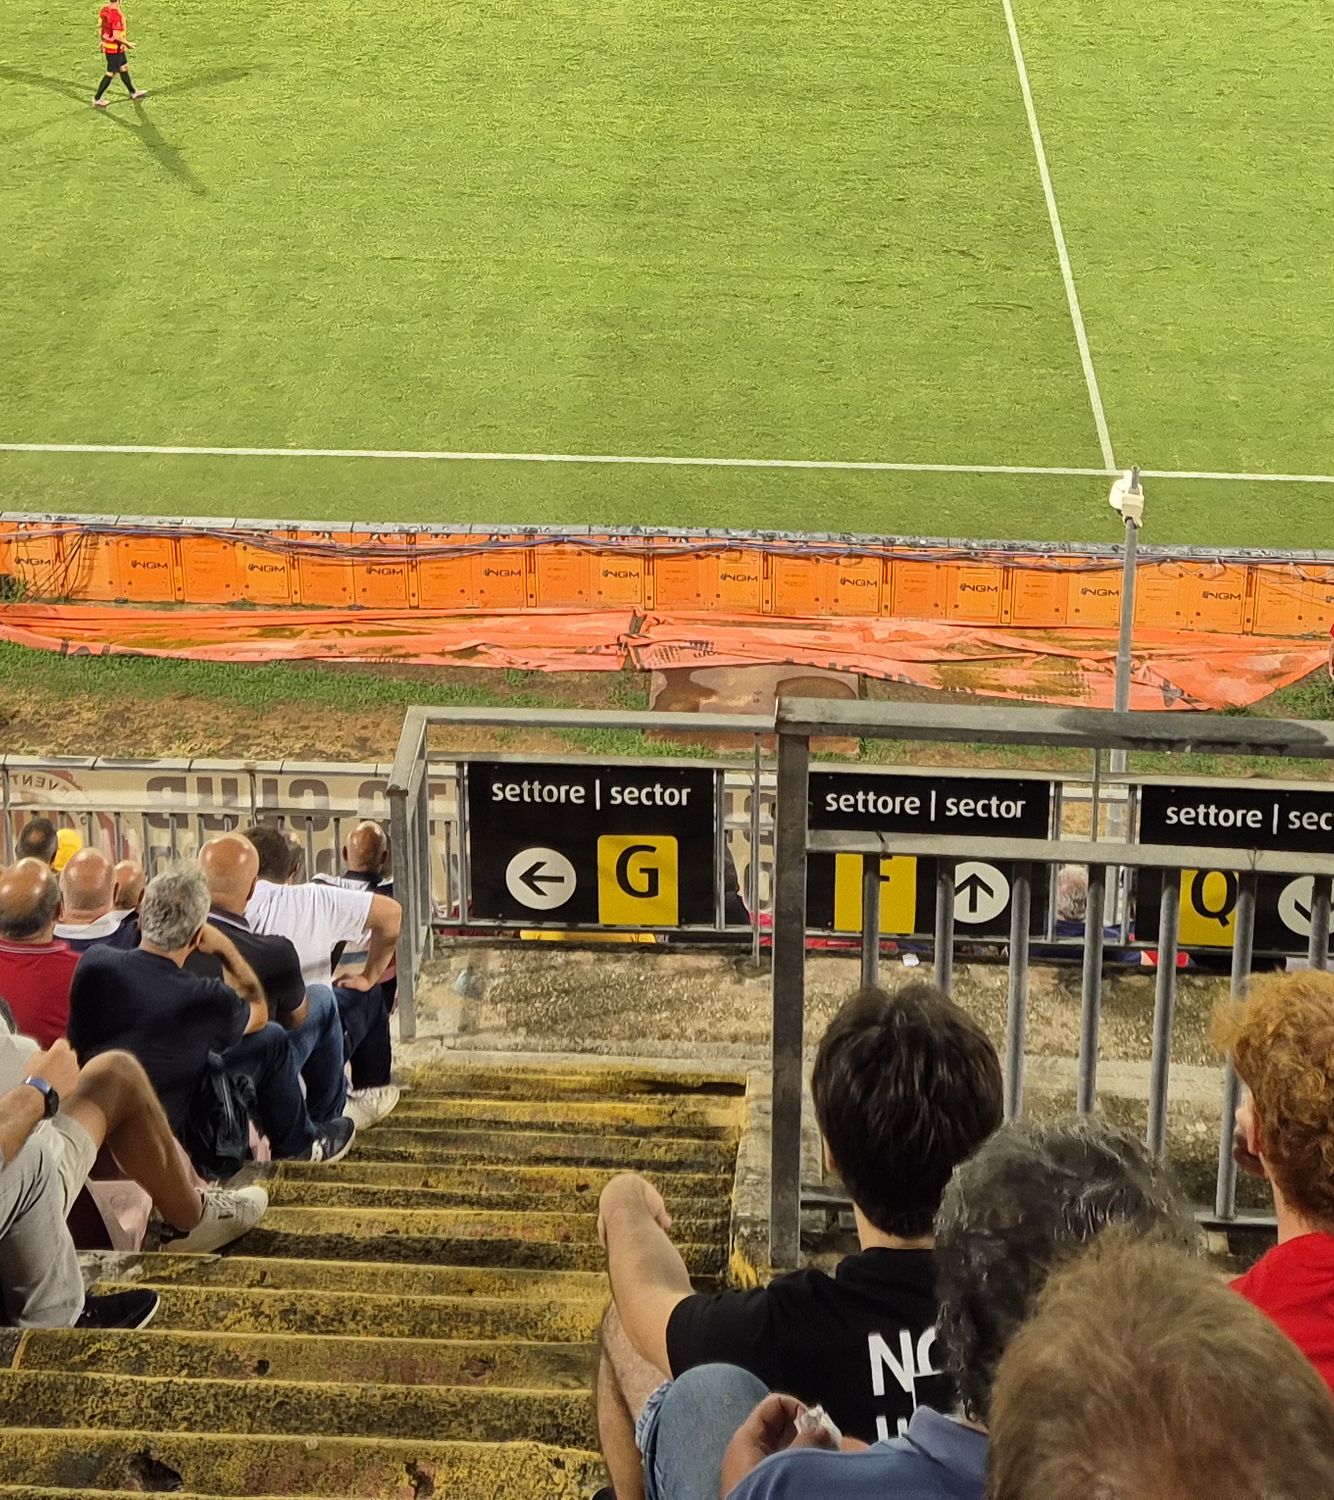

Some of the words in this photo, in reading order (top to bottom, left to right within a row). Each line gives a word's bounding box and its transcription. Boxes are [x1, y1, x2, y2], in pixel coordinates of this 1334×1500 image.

[491, 780, 586, 805] settore
[609, 783, 692, 807] sector
[825, 790, 921, 816] settore
[945, 796, 1027, 819] sector
[1165, 803, 1263, 829] settore
[615, 844, 659, 899] G
[1191, 869, 1238, 927] Q
